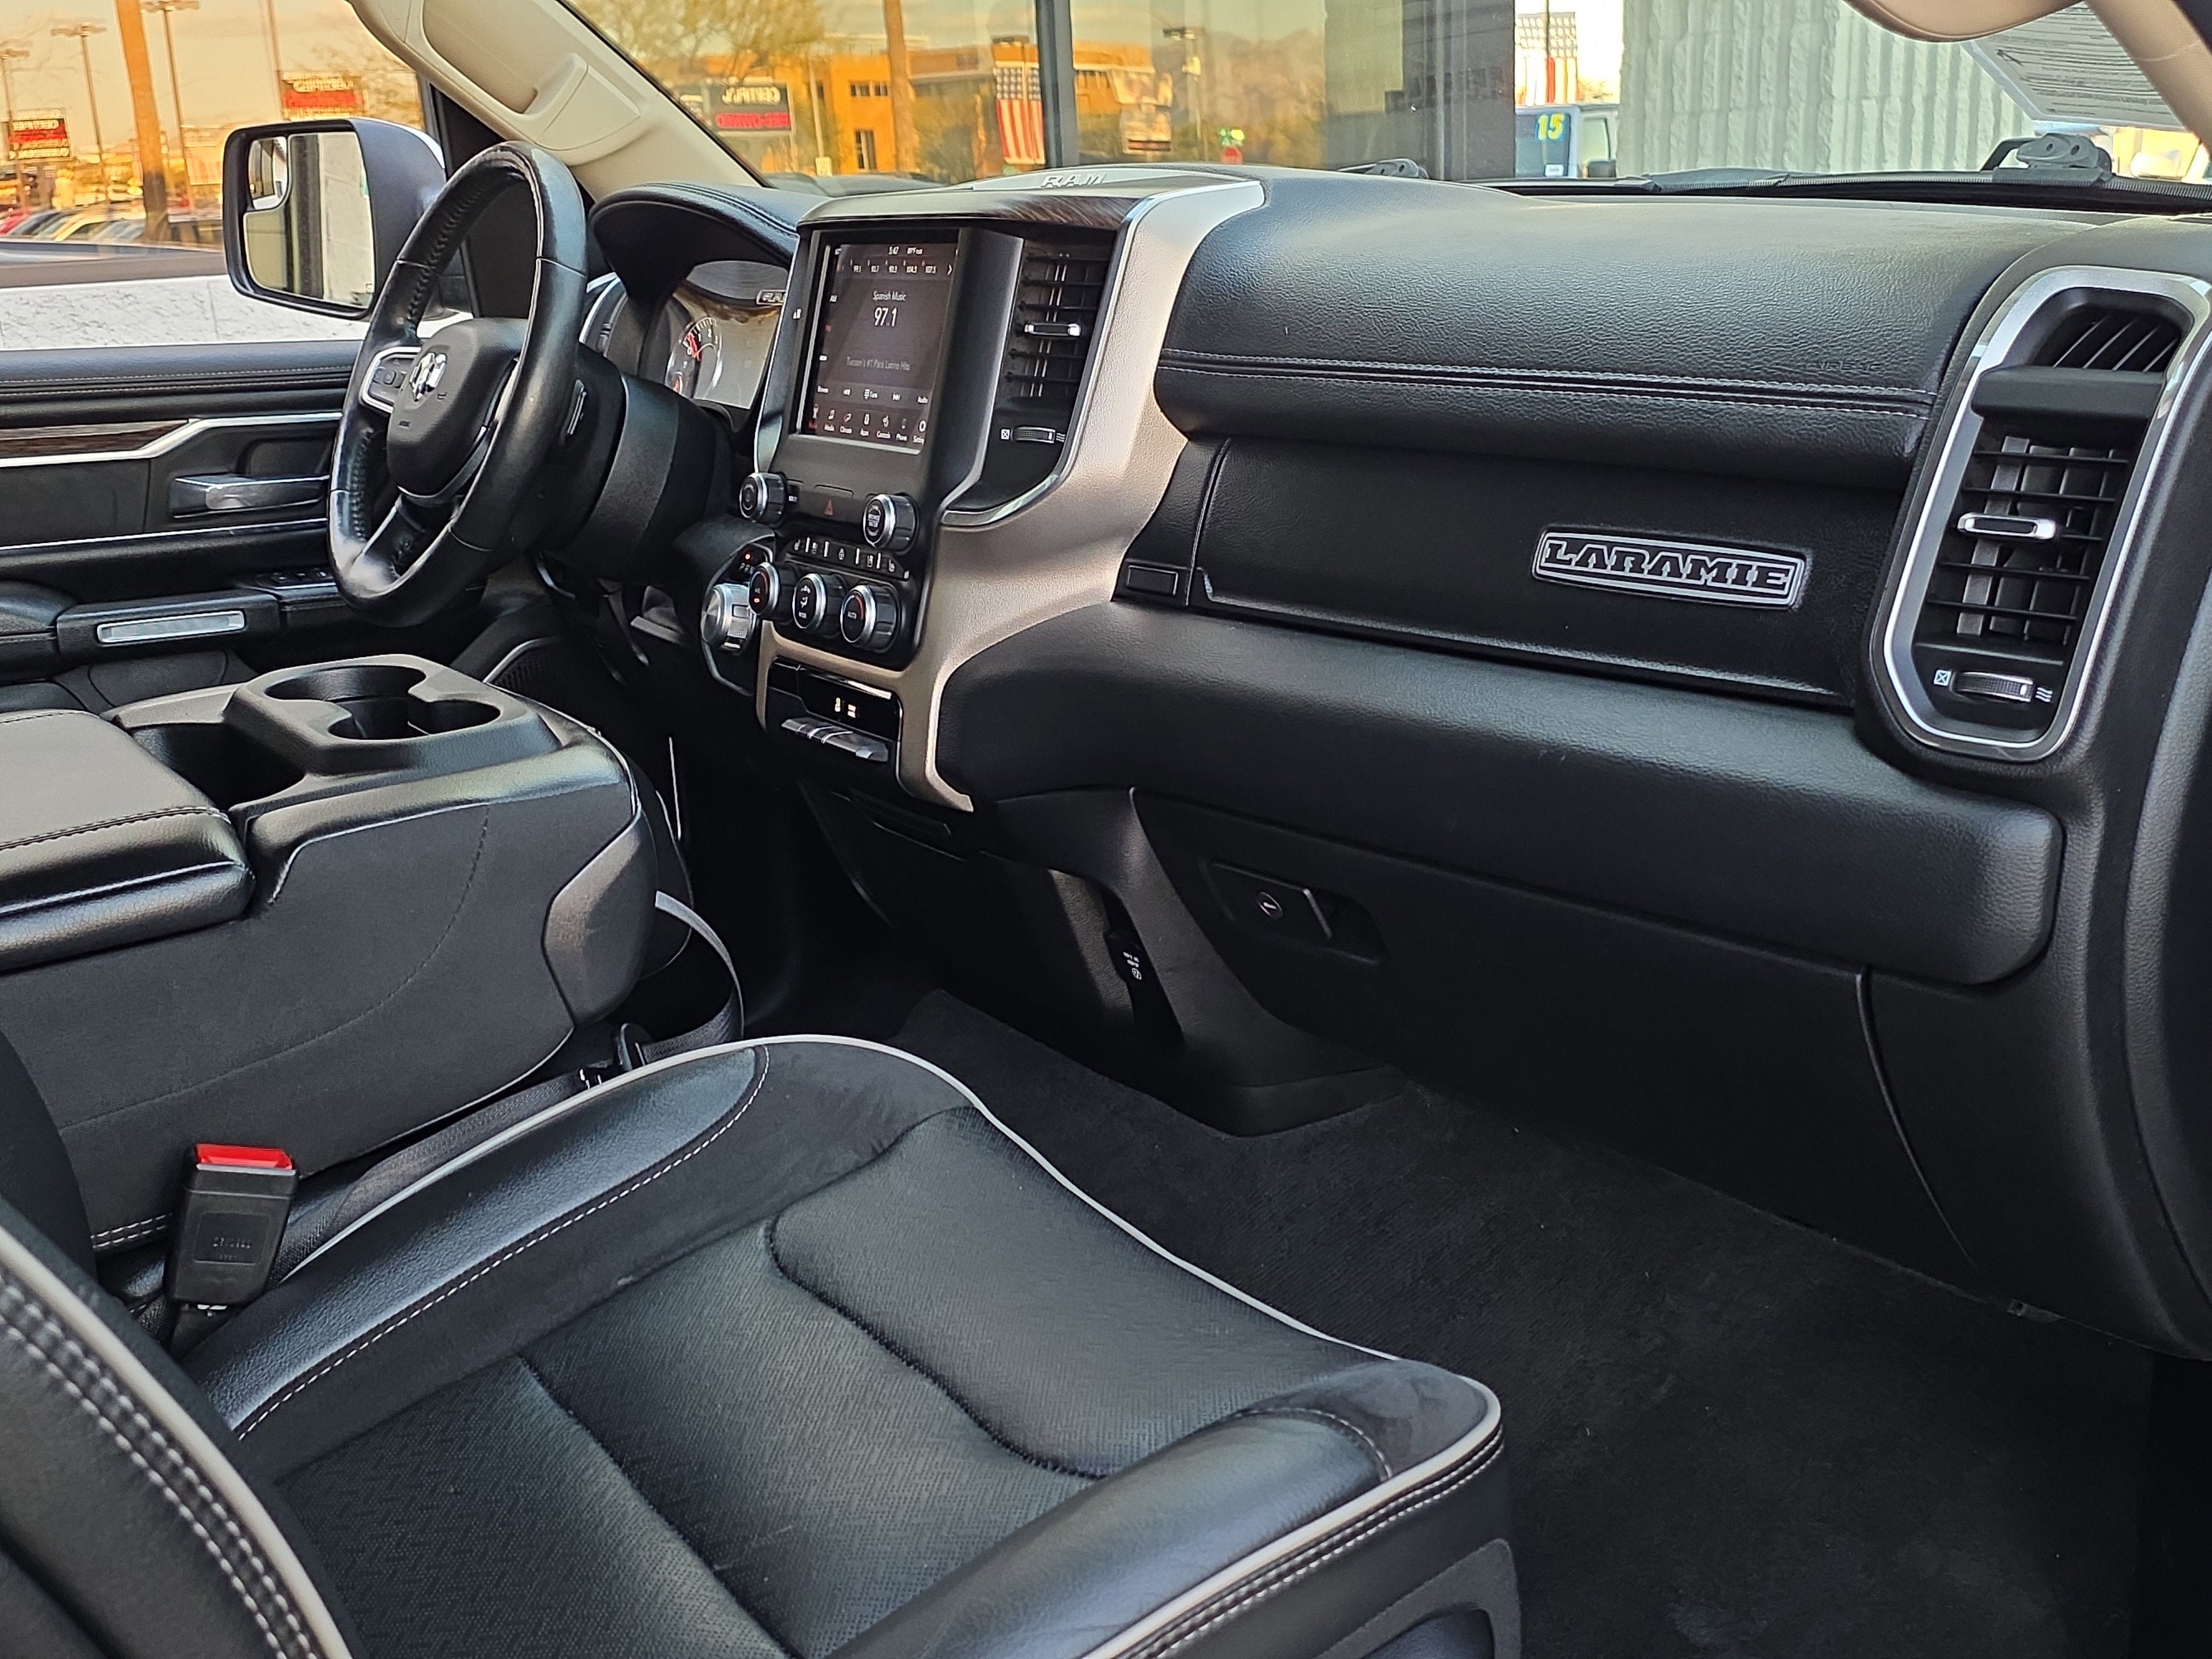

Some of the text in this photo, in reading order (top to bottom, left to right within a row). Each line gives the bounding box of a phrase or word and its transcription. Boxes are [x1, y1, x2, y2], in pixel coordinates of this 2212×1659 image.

[1538, 113, 1565, 141] 15
[1040, 173, 1107, 188] RAM
[874, 307, 897, 326] 97.1
[1543, 541, 1791, 592] LARAMIE
